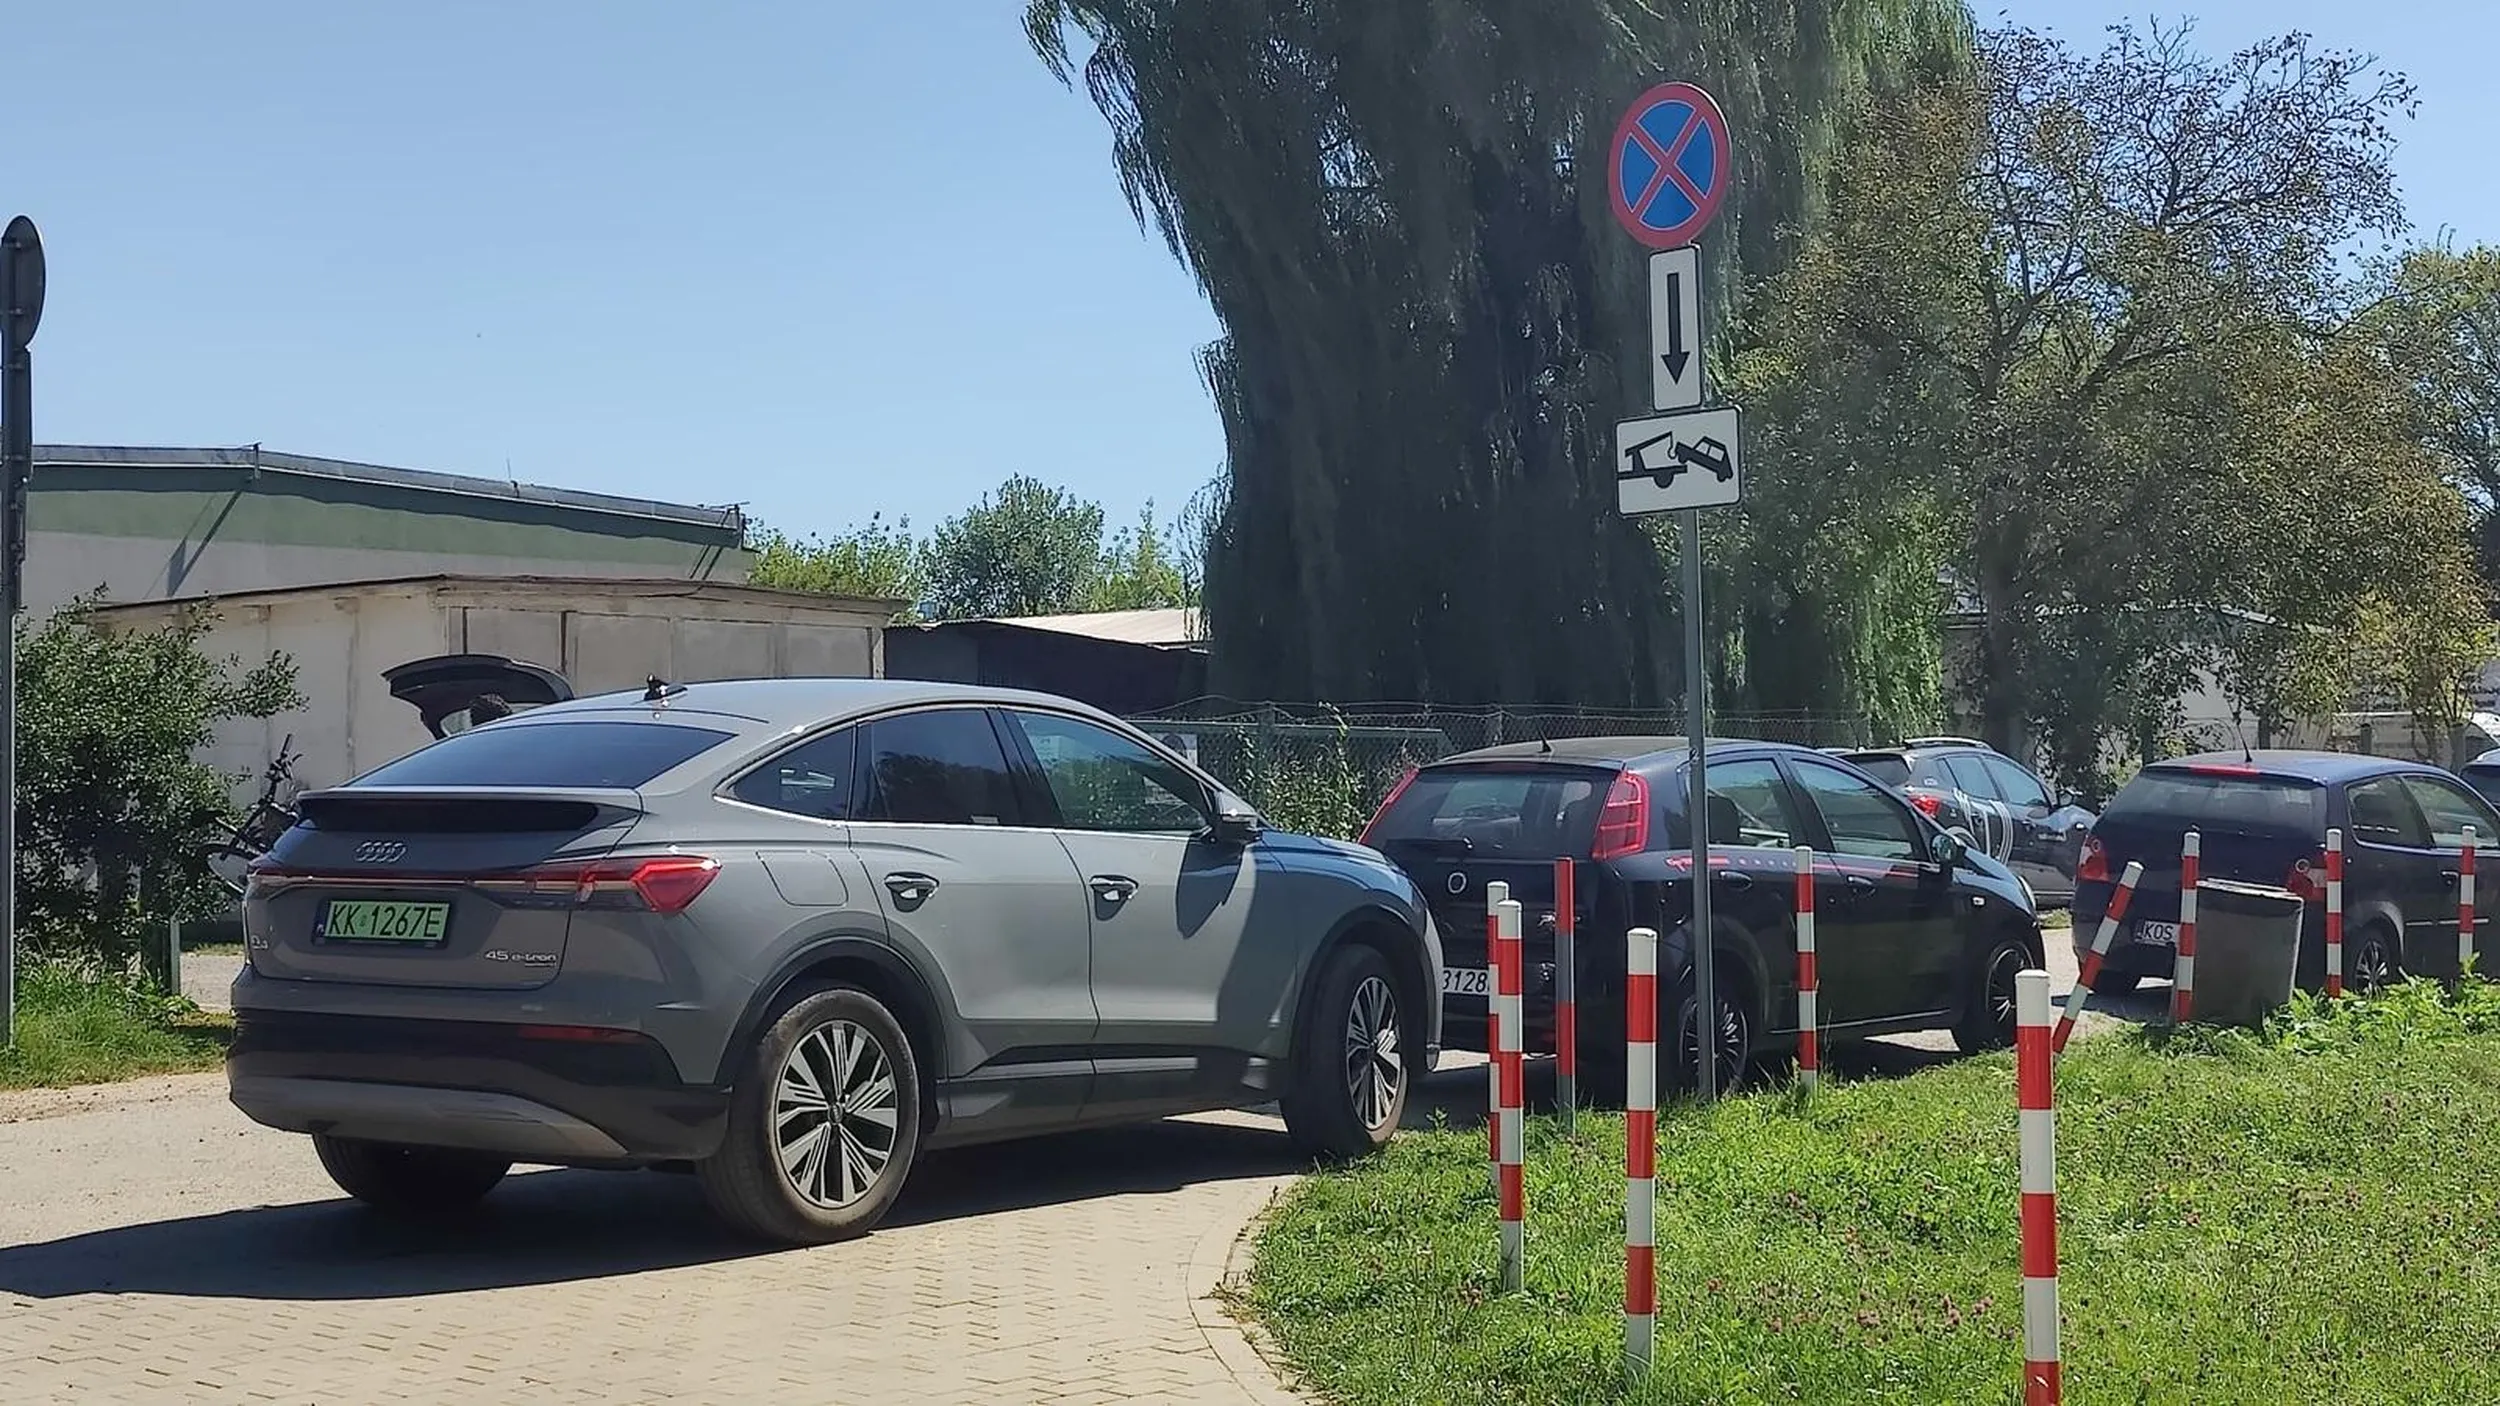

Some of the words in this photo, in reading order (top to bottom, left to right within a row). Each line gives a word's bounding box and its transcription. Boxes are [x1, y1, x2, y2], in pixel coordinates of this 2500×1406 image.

[328, 904, 361, 935] KK
[371, 905, 442, 937] 1267E
[2144, 923, 2174, 941] KOS
[1442, 969, 1489, 993] 3128
